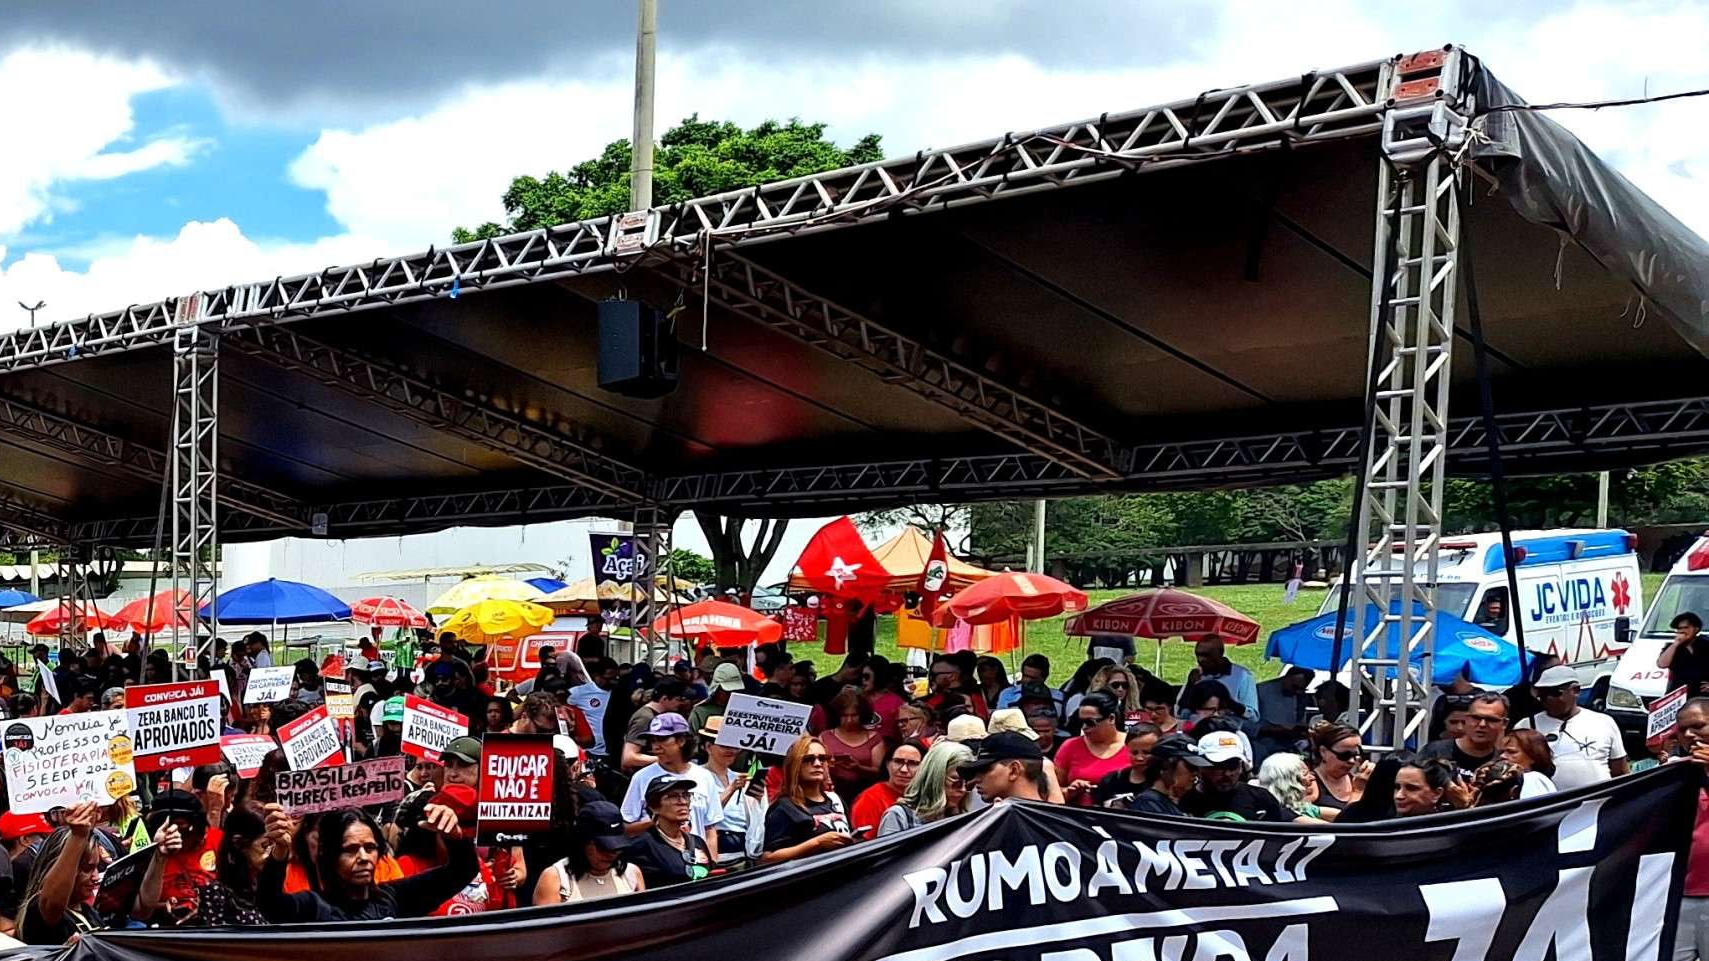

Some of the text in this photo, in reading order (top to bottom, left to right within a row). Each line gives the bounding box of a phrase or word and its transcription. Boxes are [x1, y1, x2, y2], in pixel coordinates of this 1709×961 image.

[1556, 576, 1606, 613] VIDA
[683, 615, 741, 628] BRAHMA
[1093, 618, 1130, 630] KIBON
[1161, 619, 1206, 631] KIBON
[144, 685, 205, 703] CONVOCA JÁ!
[138, 703, 209, 727] ZERA BANCO DE
[412, 714, 429, 729] ZERA
[429, 719, 451, 734] BANCO
[725, 717, 801, 736] DA CARREIRA
[727, 710, 803, 727] REESTRUTURAÇÃO
[134, 718, 215, 750] APROVADOS
[291, 737, 304, 753] ZERA
[303, 729, 321, 746] BANCO
[739, 732, 777, 751] JÁ!
[30, 733, 110, 760] PROFESSOR
[293, 734, 337, 770] APROVADOS
[12, 750, 109, 779] FISIOTERAPIA
[27, 761, 117, 790] SEEDF 2022
[487, 754, 548, 777] EDUCAR
[15, 785, 68, 803] CONVOCA
[278, 770, 402, 807] MERECE RESPEITO
[494, 773, 539, 799] NÃO É
[479, 804, 551, 818] MILITARIZAR
[903, 826, 1336, 930] RUMO À META 17
